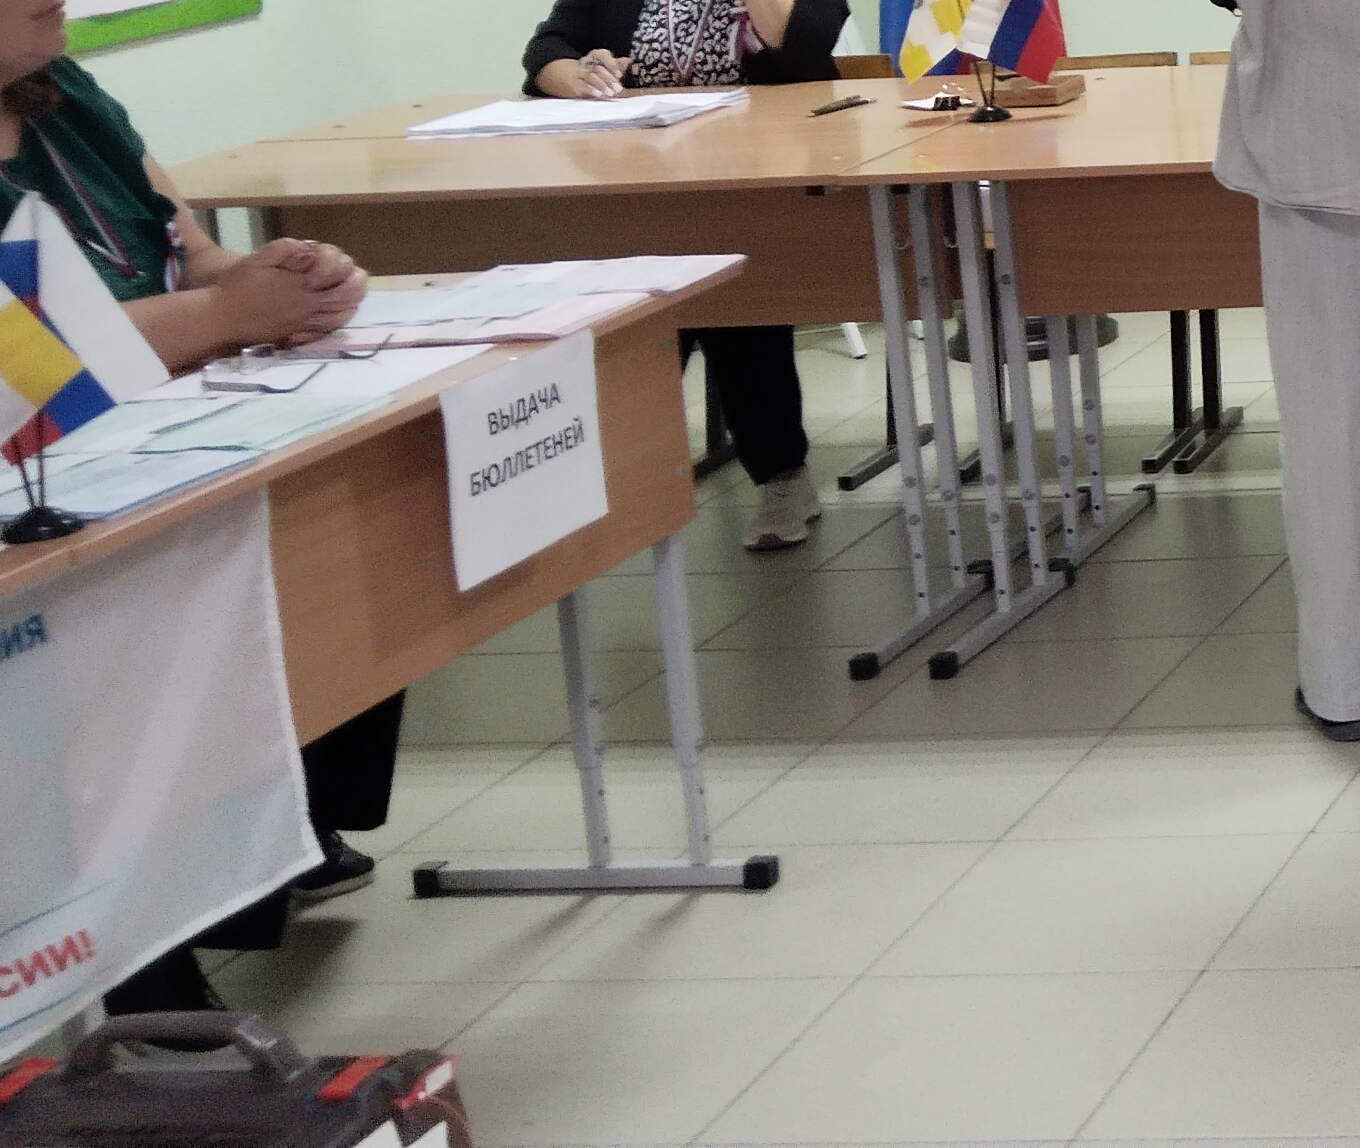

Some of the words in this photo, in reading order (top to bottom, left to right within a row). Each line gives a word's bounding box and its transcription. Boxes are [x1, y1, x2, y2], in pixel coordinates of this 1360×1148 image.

[487, 382, 562, 435] ВЫДАЧА
[470, 415, 585, 497] БЮЛЛЕТЕНЕЙ
[0, 929, 95, 998] СИИ!
